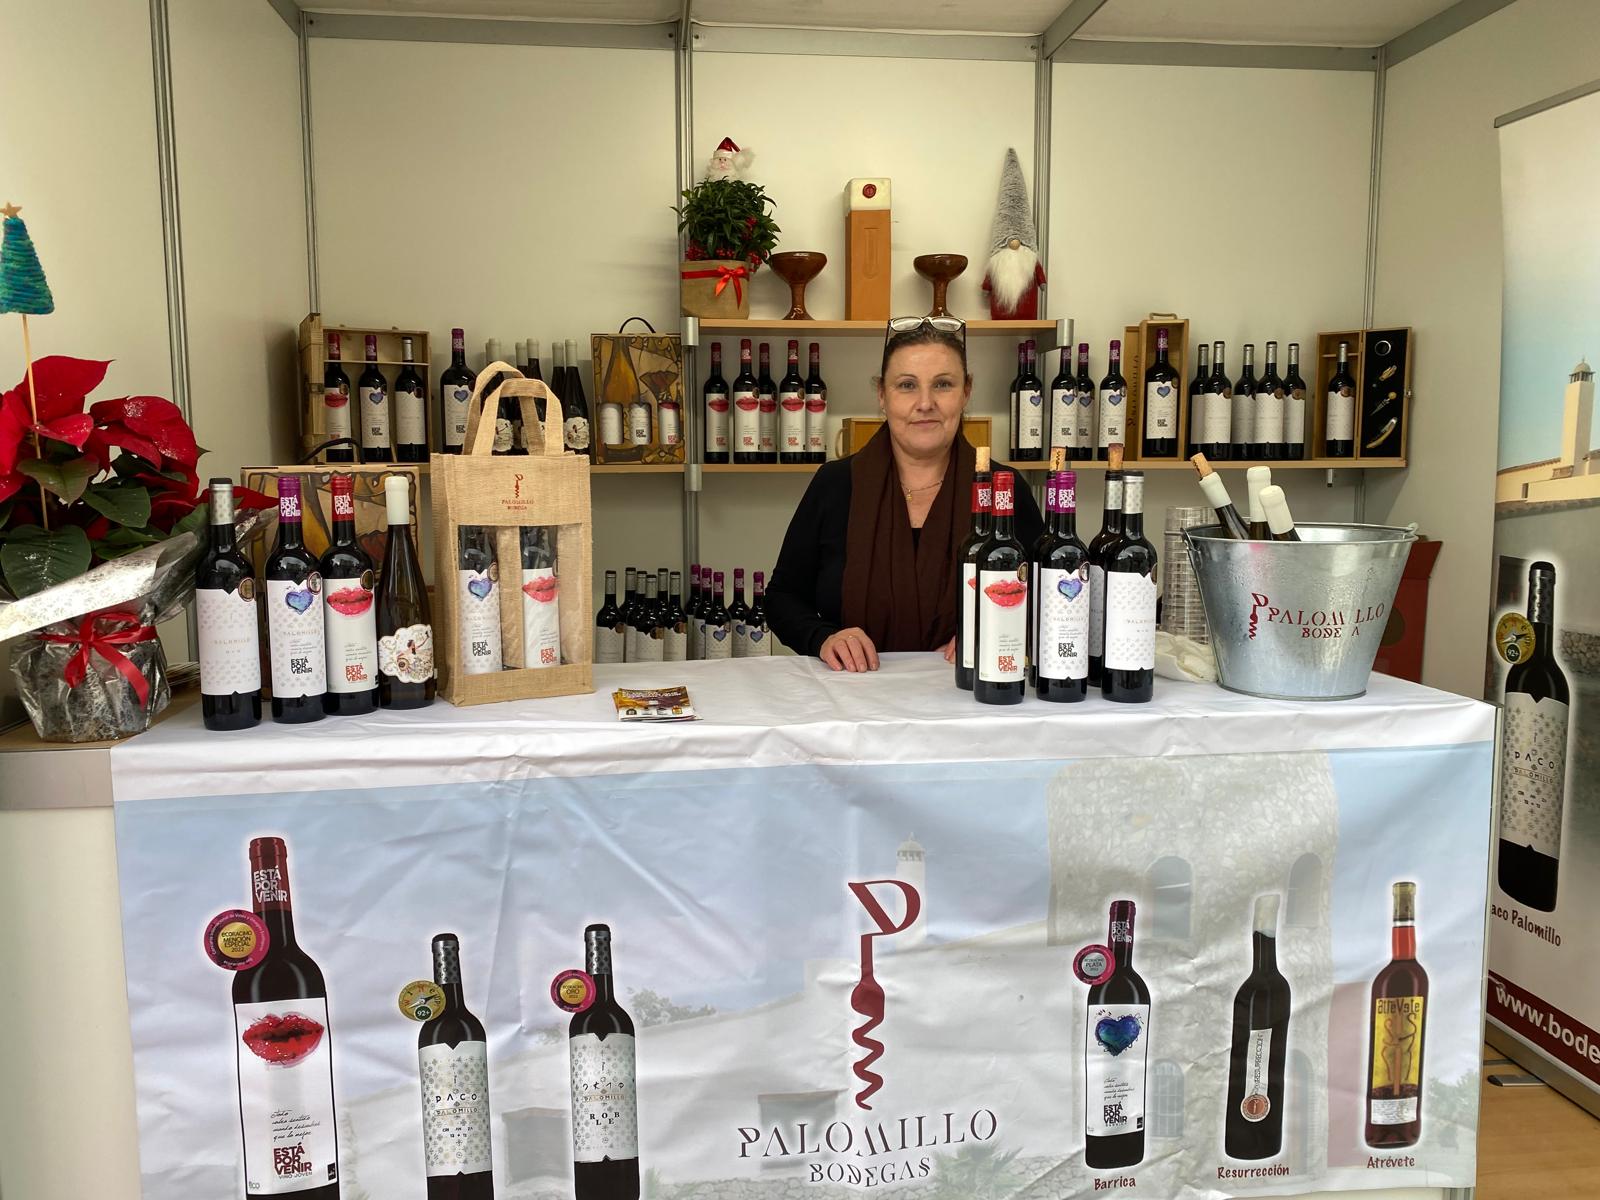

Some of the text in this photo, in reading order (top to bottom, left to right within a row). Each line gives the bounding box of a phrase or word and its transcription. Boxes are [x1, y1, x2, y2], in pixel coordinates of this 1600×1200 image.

[1267, 602, 1385, 626] PALOMLLO
[1302, 626, 1360, 639] BODEA
[290, 656, 308, 665] ESTÁ
[346, 663, 364, 671] ESTÁ
[254, 864, 282, 881] ESTÁ
[254, 880, 278, 892] POR
[256, 890, 288, 903] VENIR
[1112, 920, 1130, 929] ESTÁ
[1512, 909, 1562, 946] Palomillo
[436, 1093, 478, 1102] PACO
[1104, 1100, 1123, 1111] ESTÁ
[1104, 1110, 1120, 1118] POR
[1104, 1116, 1128, 1124] VENIR
[737, 1108, 998, 1158] PALOMILLO
[274, 1142, 306, 1156] ESTÁ
[274, 1155, 301, 1167] POR
[1366, 1156, 1415, 1169] Atrévete
[274, 1162, 312, 1176] VENIR
[809, 1156, 931, 1188] BODEGAS
[1217, 1164, 1290, 1179] Resurrección
[1094, 1176, 1136, 1190] Barrica
